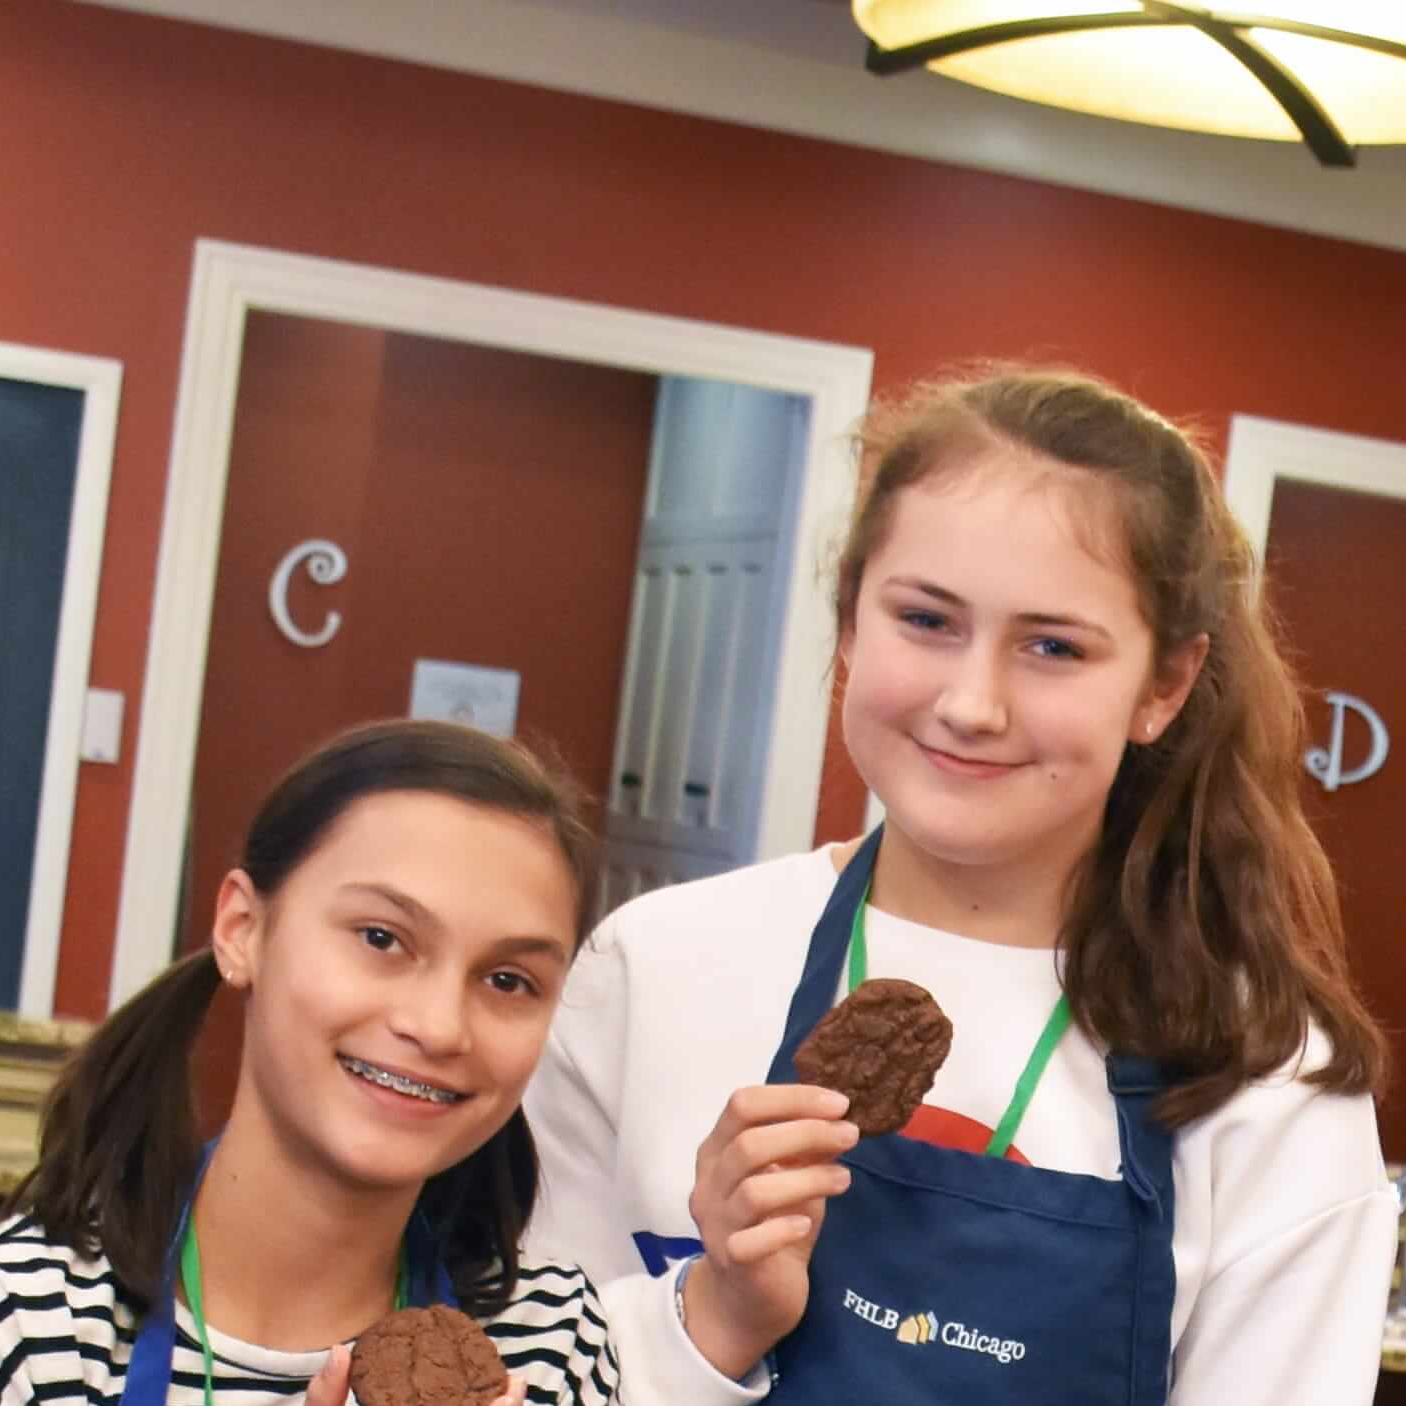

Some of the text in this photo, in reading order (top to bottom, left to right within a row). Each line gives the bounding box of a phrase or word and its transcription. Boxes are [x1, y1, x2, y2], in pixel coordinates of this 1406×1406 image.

[269, 539, 349, 648] C
[1304, 688, 1391, 792] D
[843, 1288, 1025, 1364] FHLB Chicago
